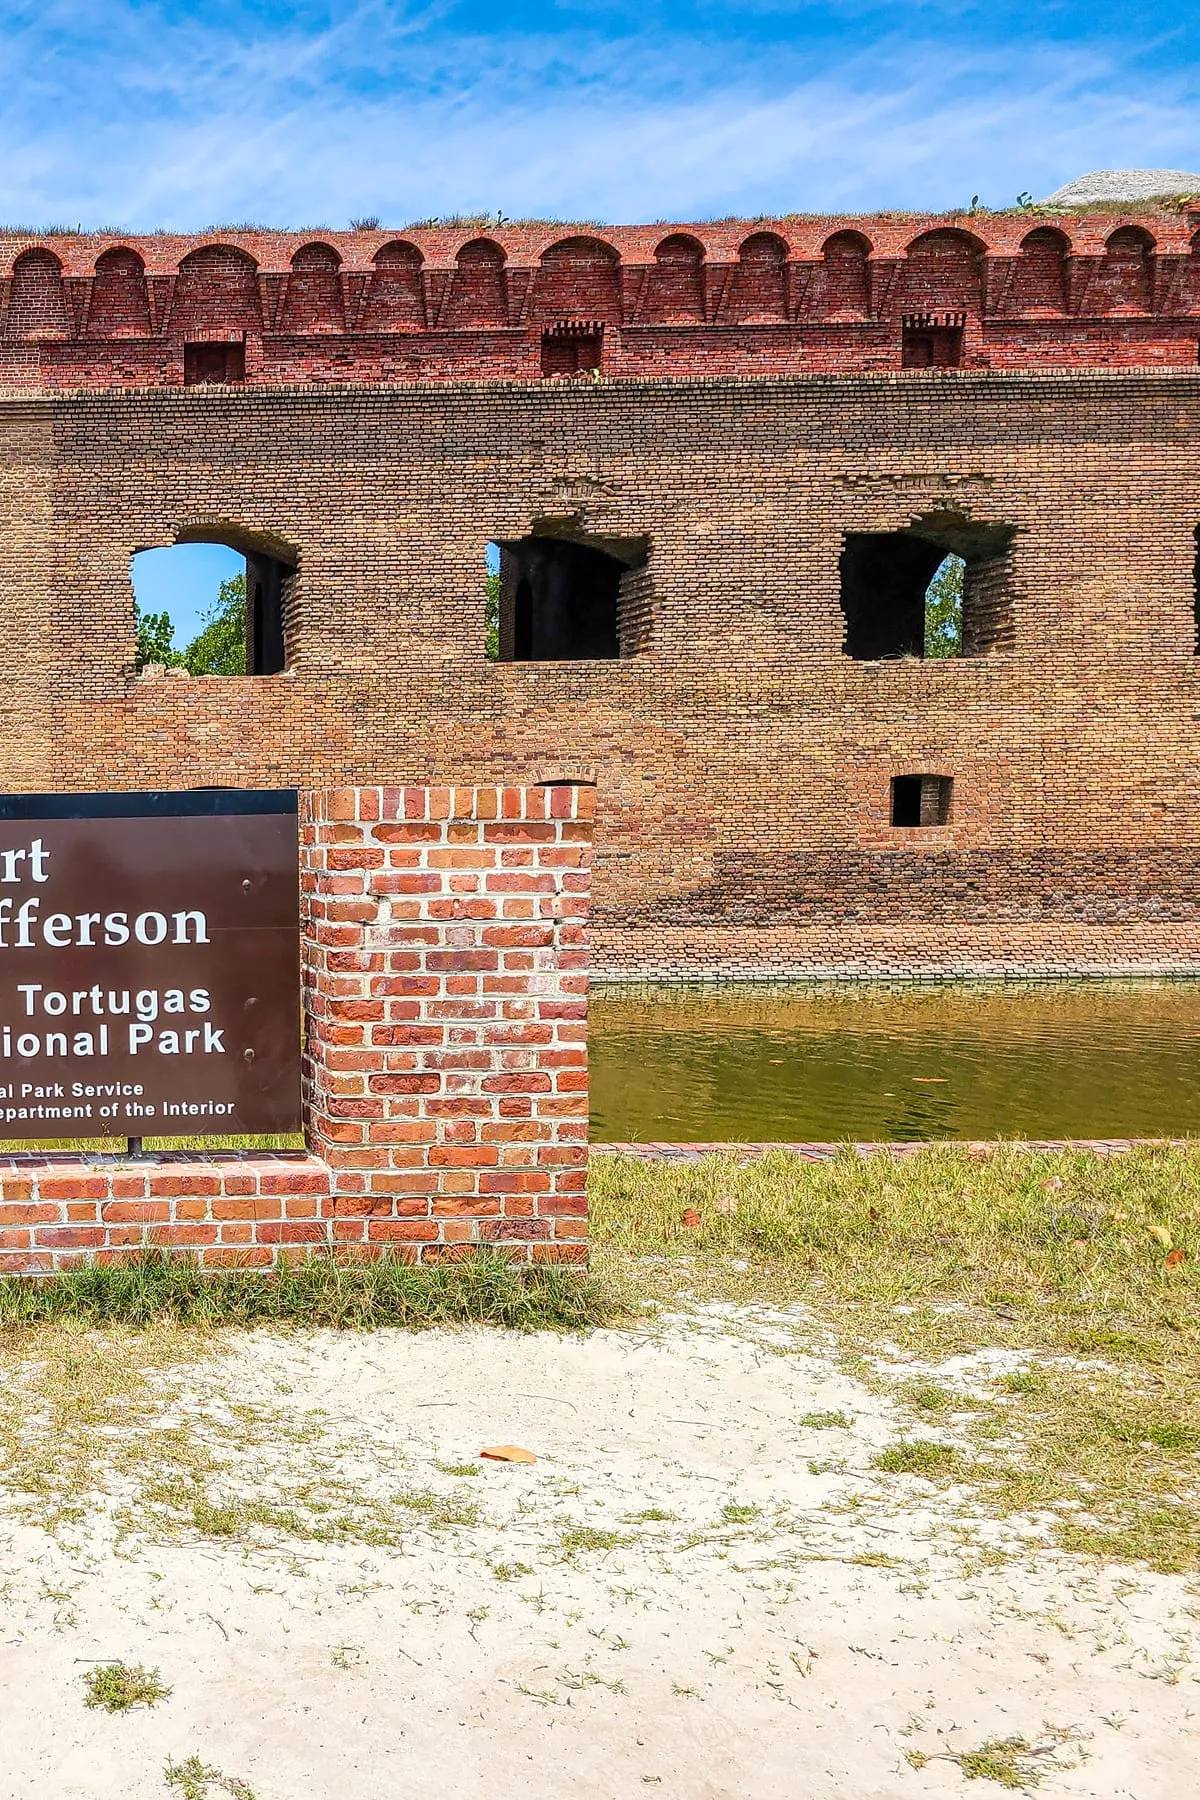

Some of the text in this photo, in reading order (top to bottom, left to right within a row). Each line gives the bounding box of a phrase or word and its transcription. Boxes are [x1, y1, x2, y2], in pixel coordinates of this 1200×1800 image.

[17, 983, 211, 1022] Tortugas
[128, 1017, 226, 1055] Park
[21, 1082, 65, 1098] Park
[71, 1081, 144, 1097] Service
[99, 1102, 119, 1117] of
[124, 1101, 156, 1117] the
[163, 1100, 235, 1116] Interior
